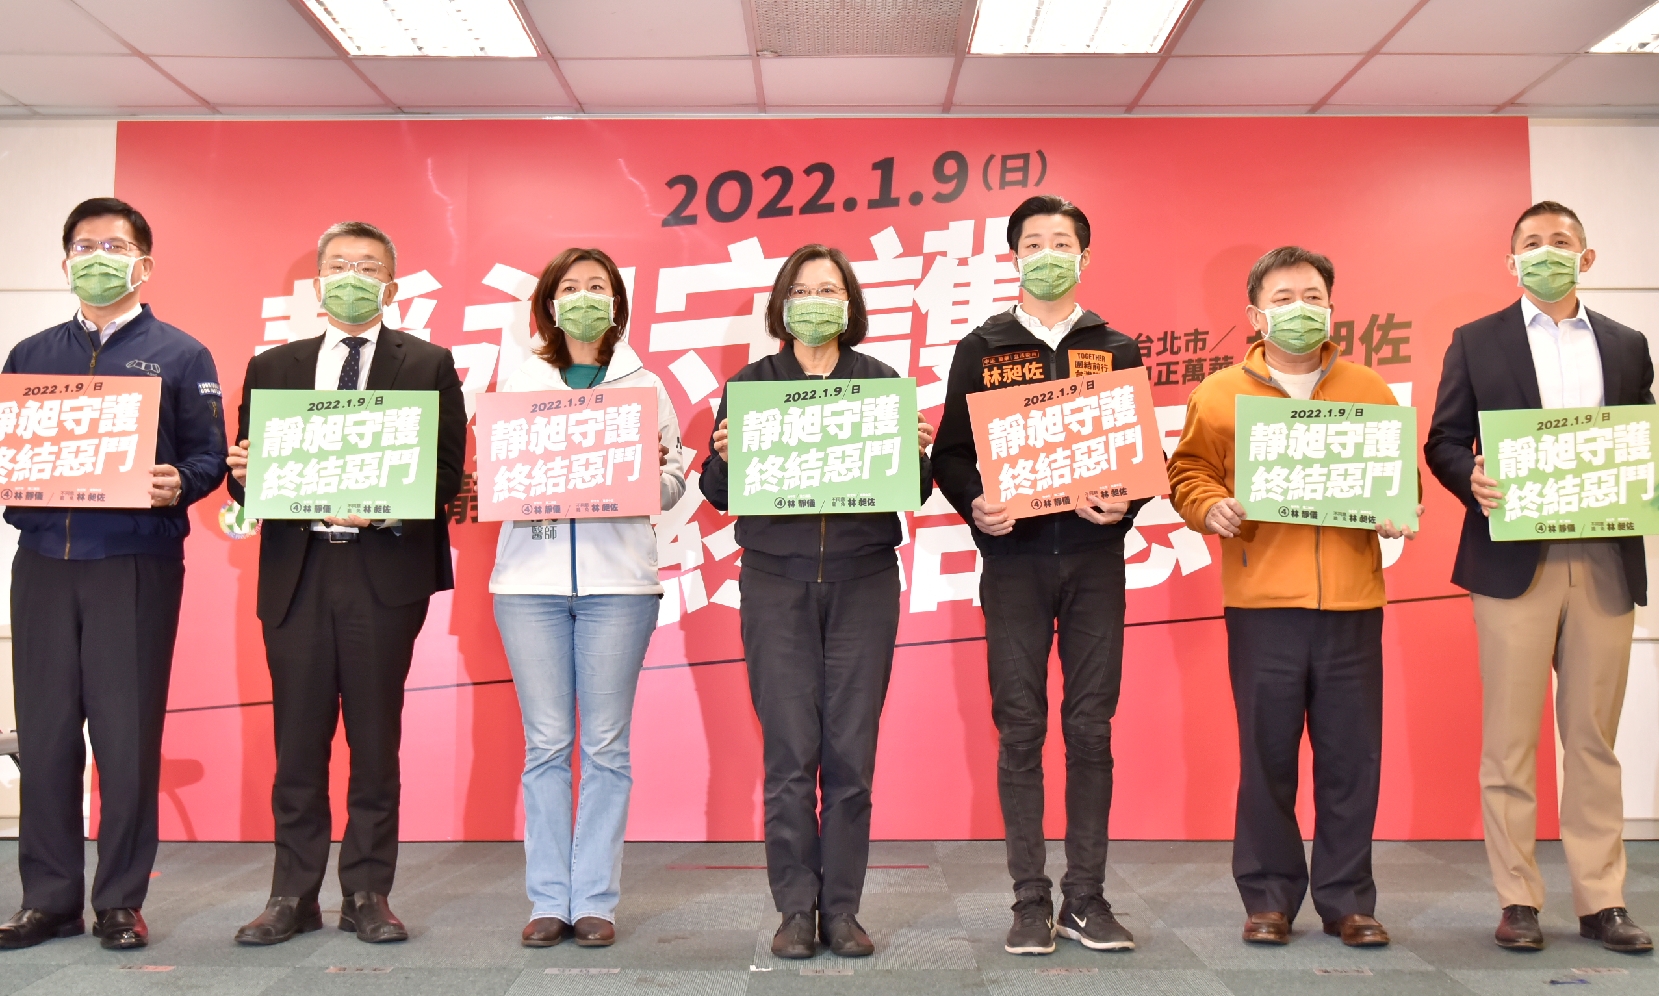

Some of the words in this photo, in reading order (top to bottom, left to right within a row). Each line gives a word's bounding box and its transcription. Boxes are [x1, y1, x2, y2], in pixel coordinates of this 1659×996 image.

[661, 150, 970, 228] 2022.1.9
[1077, 353, 1106, 363] TOGETHER
[982, 361, 1045, 388] 林昶佐
[23, 383, 84, 396] 2022.1.9
[93, 382, 103, 391] 日
[783, 387, 843, 404] 2022.1.9
[851, 384, 861, 395] 日
[1023, 384, 1078, 407] 2022.1.9
[1086, 380, 1095, 391] 日
[307, 397, 366, 412] 2022.1.9
[374, 396, 384, 405] 日
[530, 396, 586, 413] 2022.1.9
[595, 394, 604, 404] 日
[1290, 408, 1346, 419] 2022.1.9
[1355, 408, 1364, 417] 日
[262, 406, 422, 458] 靜昶守護
[490, 402, 642, 462] 靜昶守護
[742, 393, 900, 453] 靜昶守護
[987, 384, 1138, 461] 靜昶守護
[1536, 415, 1593, 431] 2022.1.9
[1601, 412, 1611, 422] 日
[1249, 420, 1402, 462] 靜昶守護
[1498, 421, 1652, 480] 靜昶守護
[531, 526, 557, 540] 醫師
